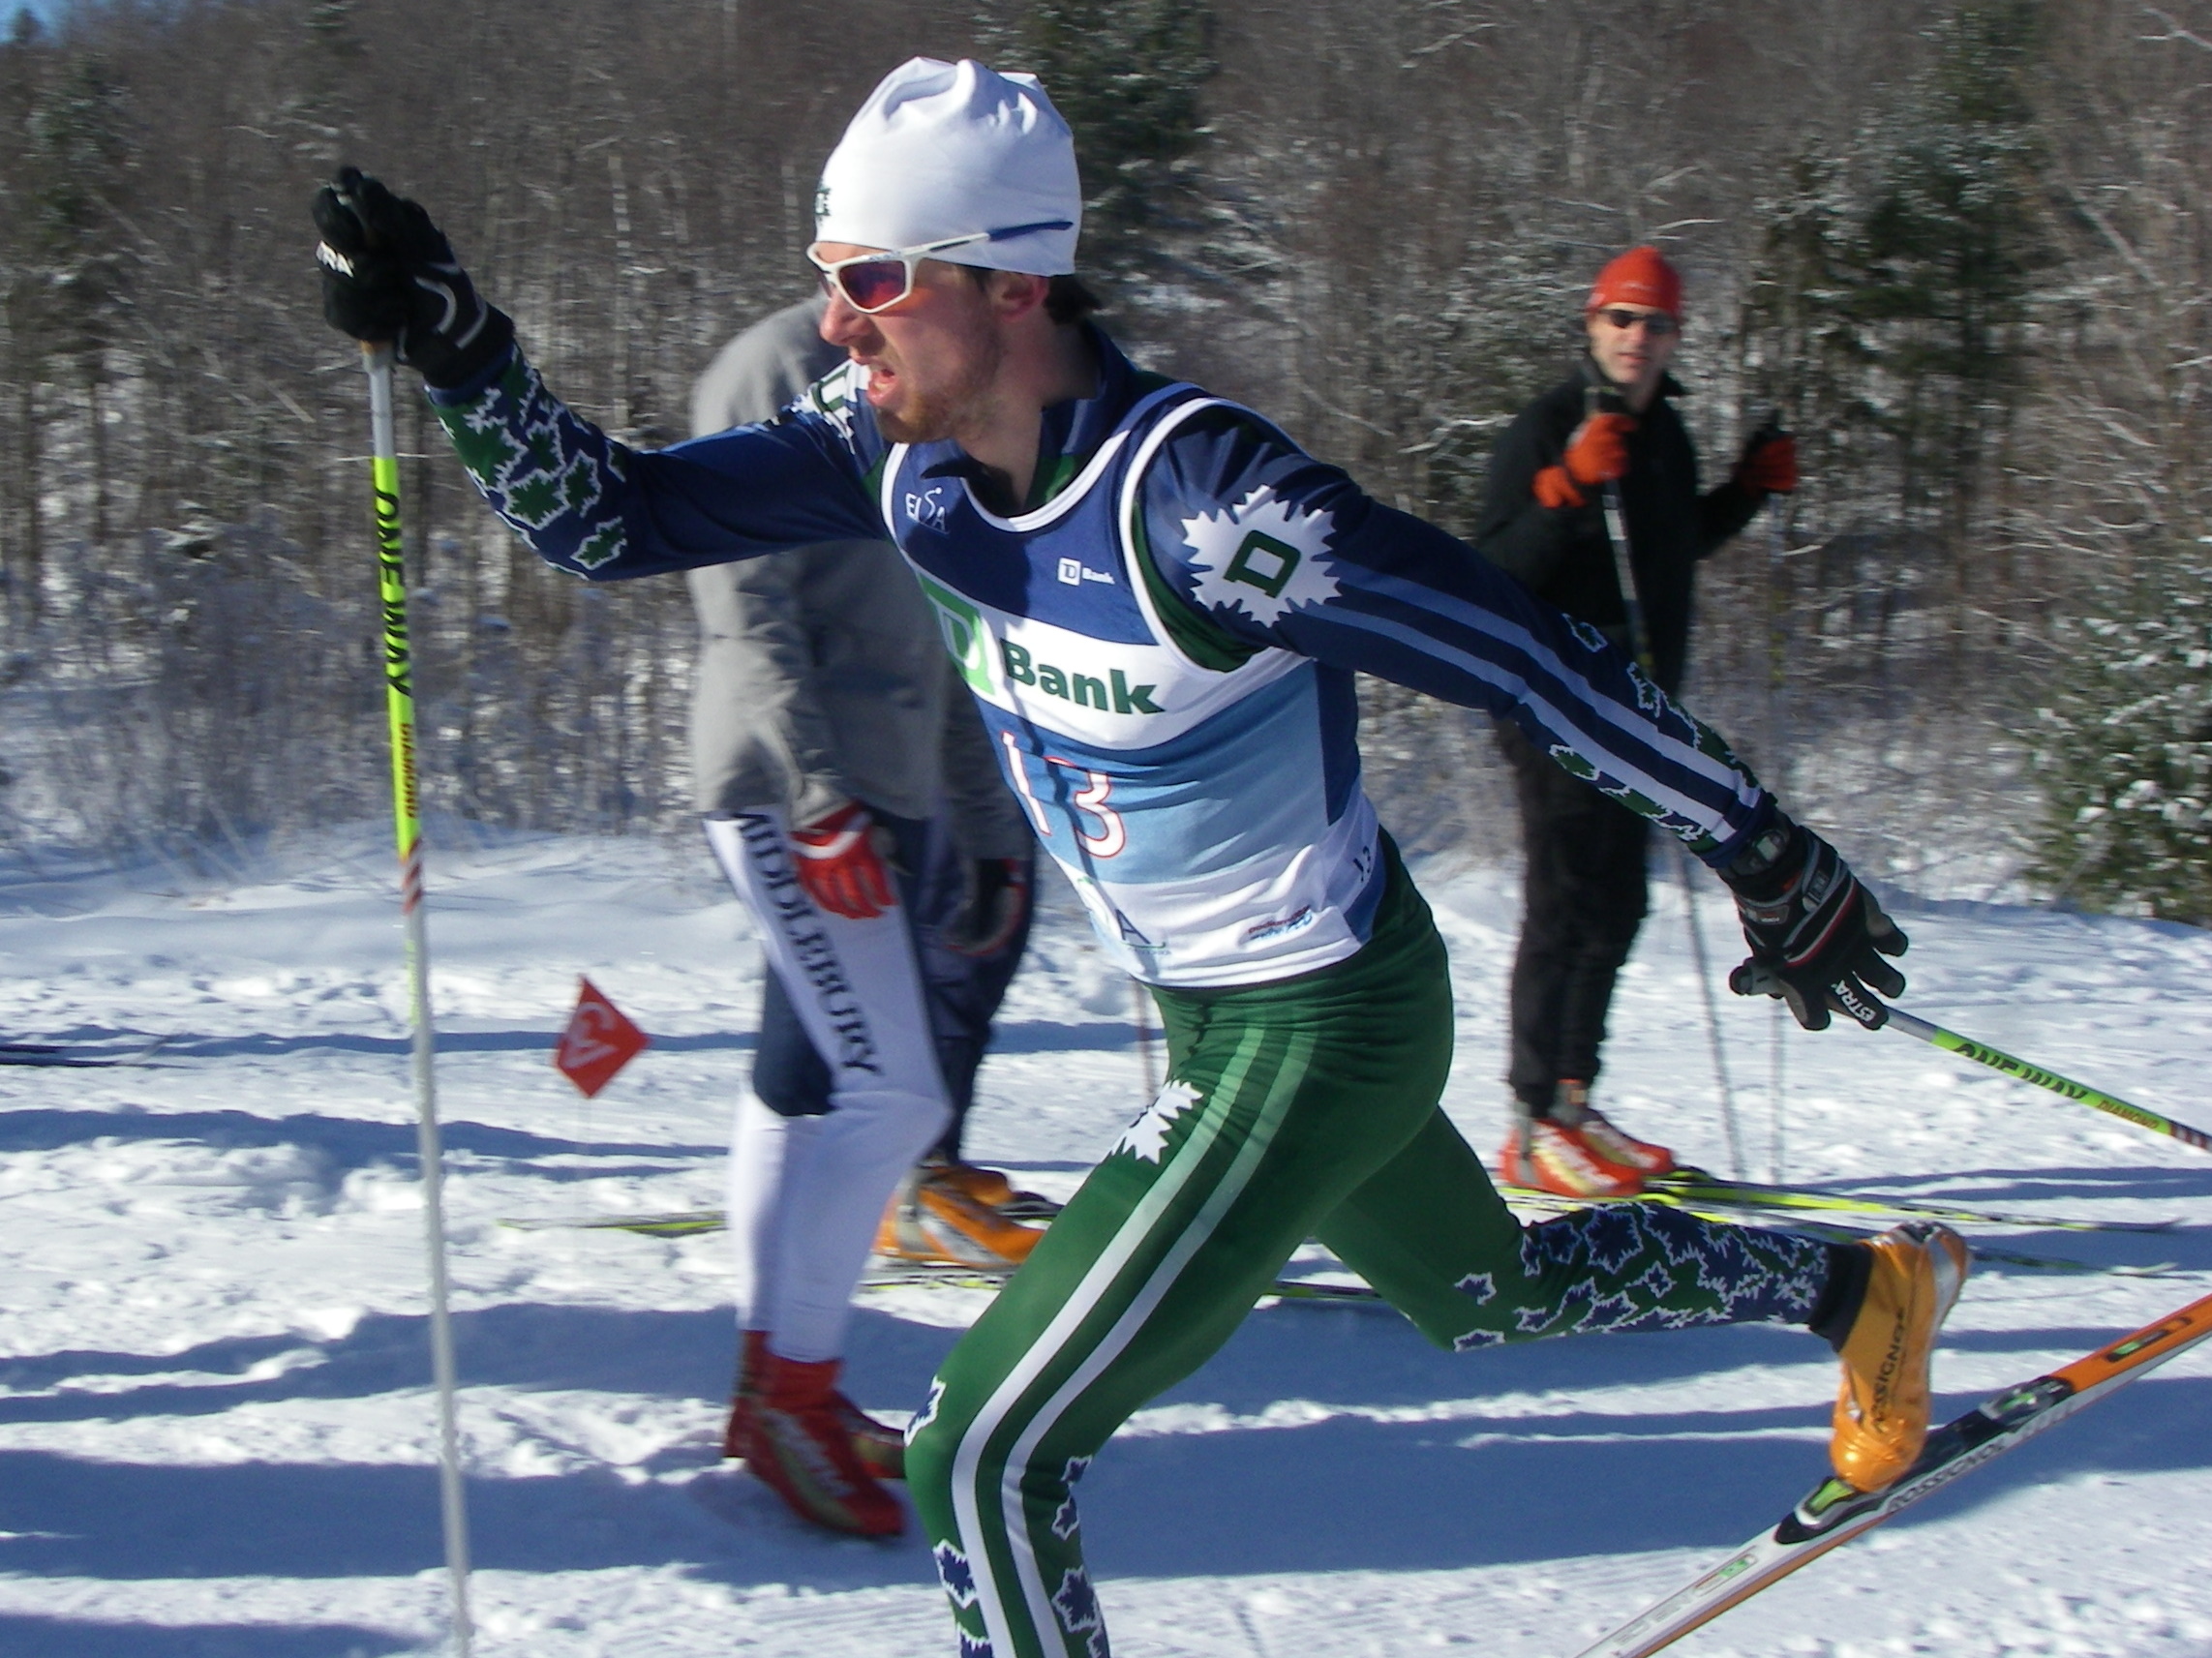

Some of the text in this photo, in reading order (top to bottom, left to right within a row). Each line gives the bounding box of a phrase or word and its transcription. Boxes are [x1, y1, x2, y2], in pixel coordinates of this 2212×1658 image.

[376, 491, 412, 696] ONE WAY
[1081, 566, 1115, 585] Bank
[1221, 529, 1302, 599] D
[999, 637, 1167, 714] Bank
[1000, 730, 1127, 859] 13
